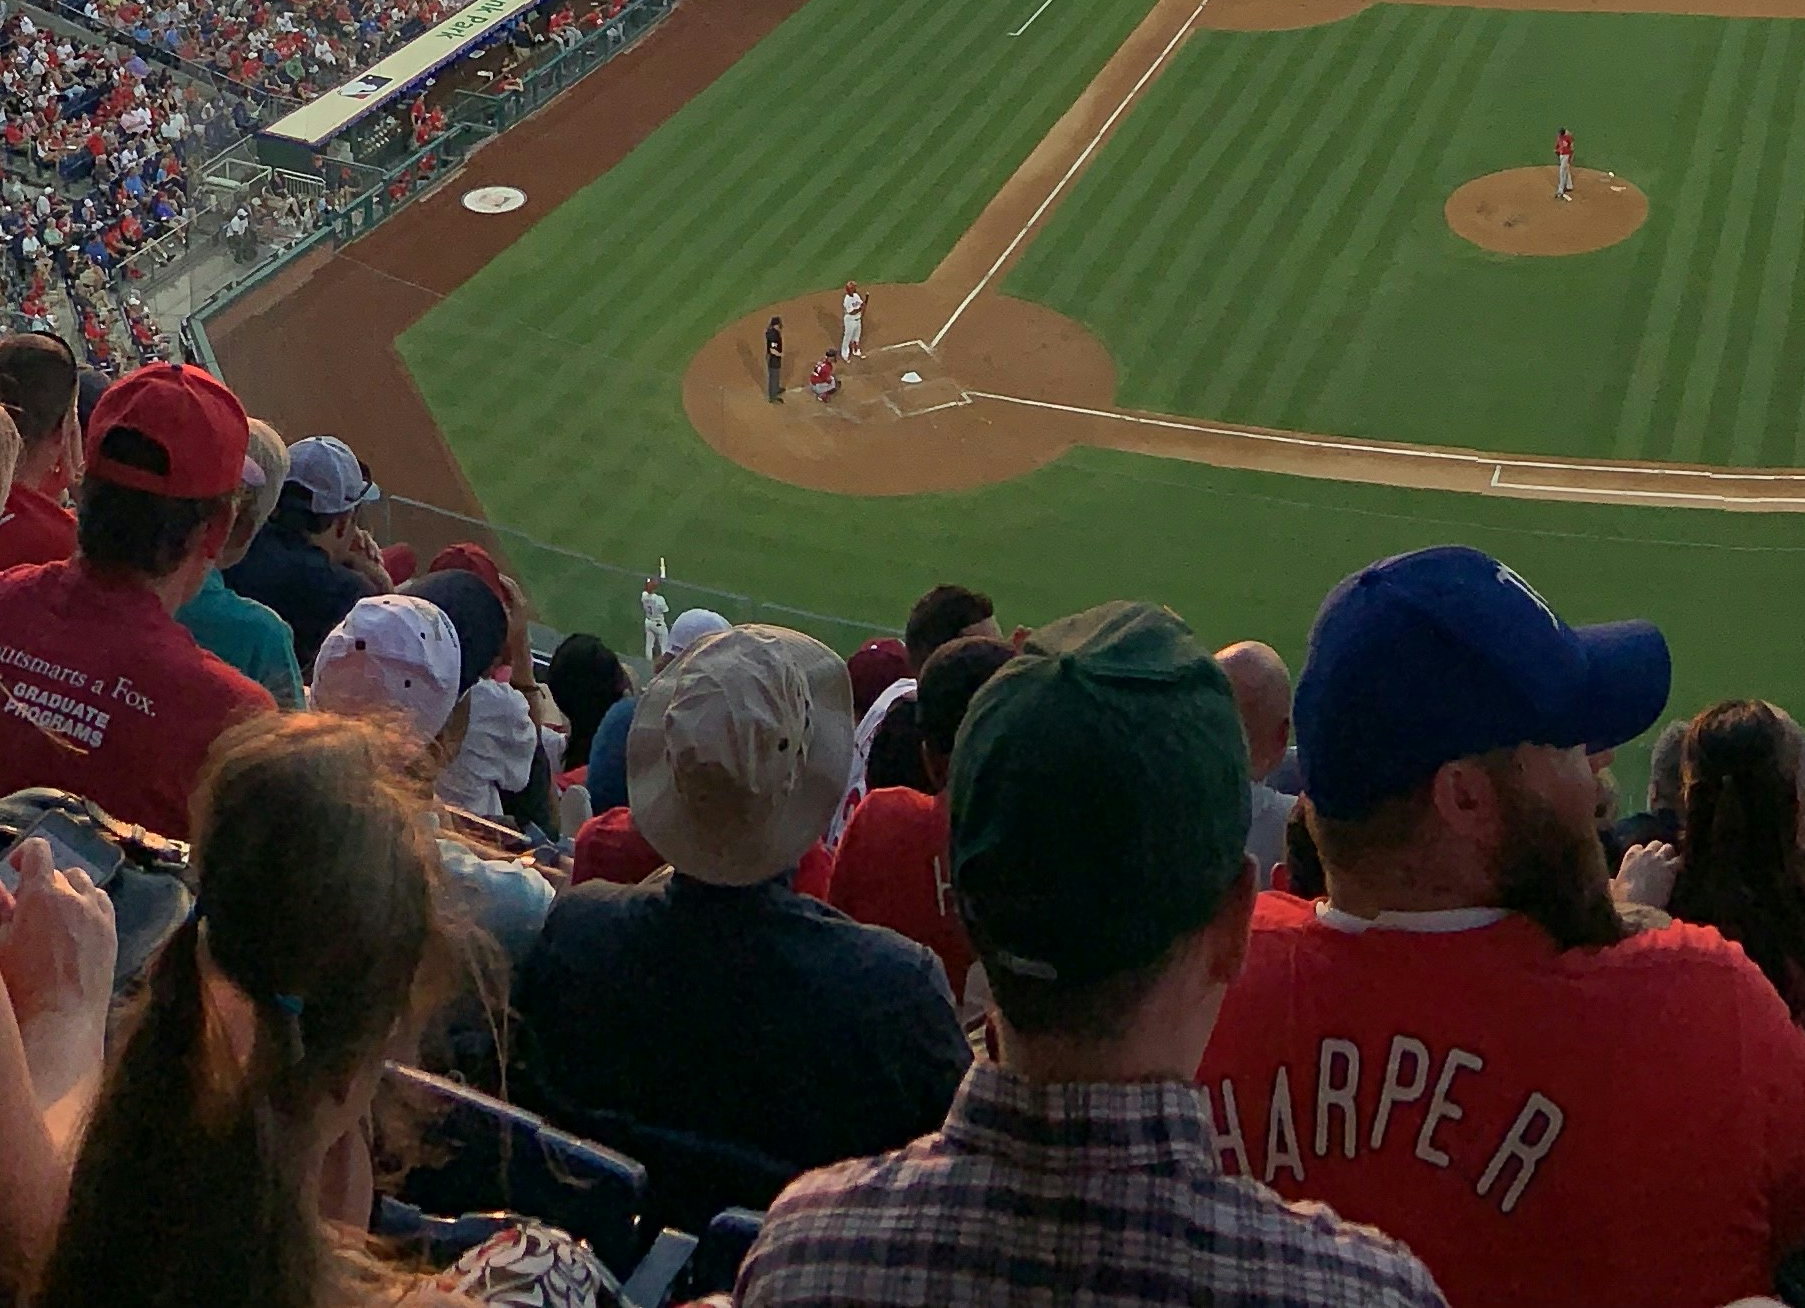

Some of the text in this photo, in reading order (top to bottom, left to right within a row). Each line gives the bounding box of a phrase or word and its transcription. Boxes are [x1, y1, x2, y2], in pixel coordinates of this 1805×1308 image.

[437, 15, 488, 39] Park
[13, 682, 110, 729] GRADUATE
[91, 679, 104, 695] a
[112, 676, 157, 718] Fox.
[4, 698, 103, 748] PROGRAMS
[1202, 1034, 1565, 1213] HARPER
